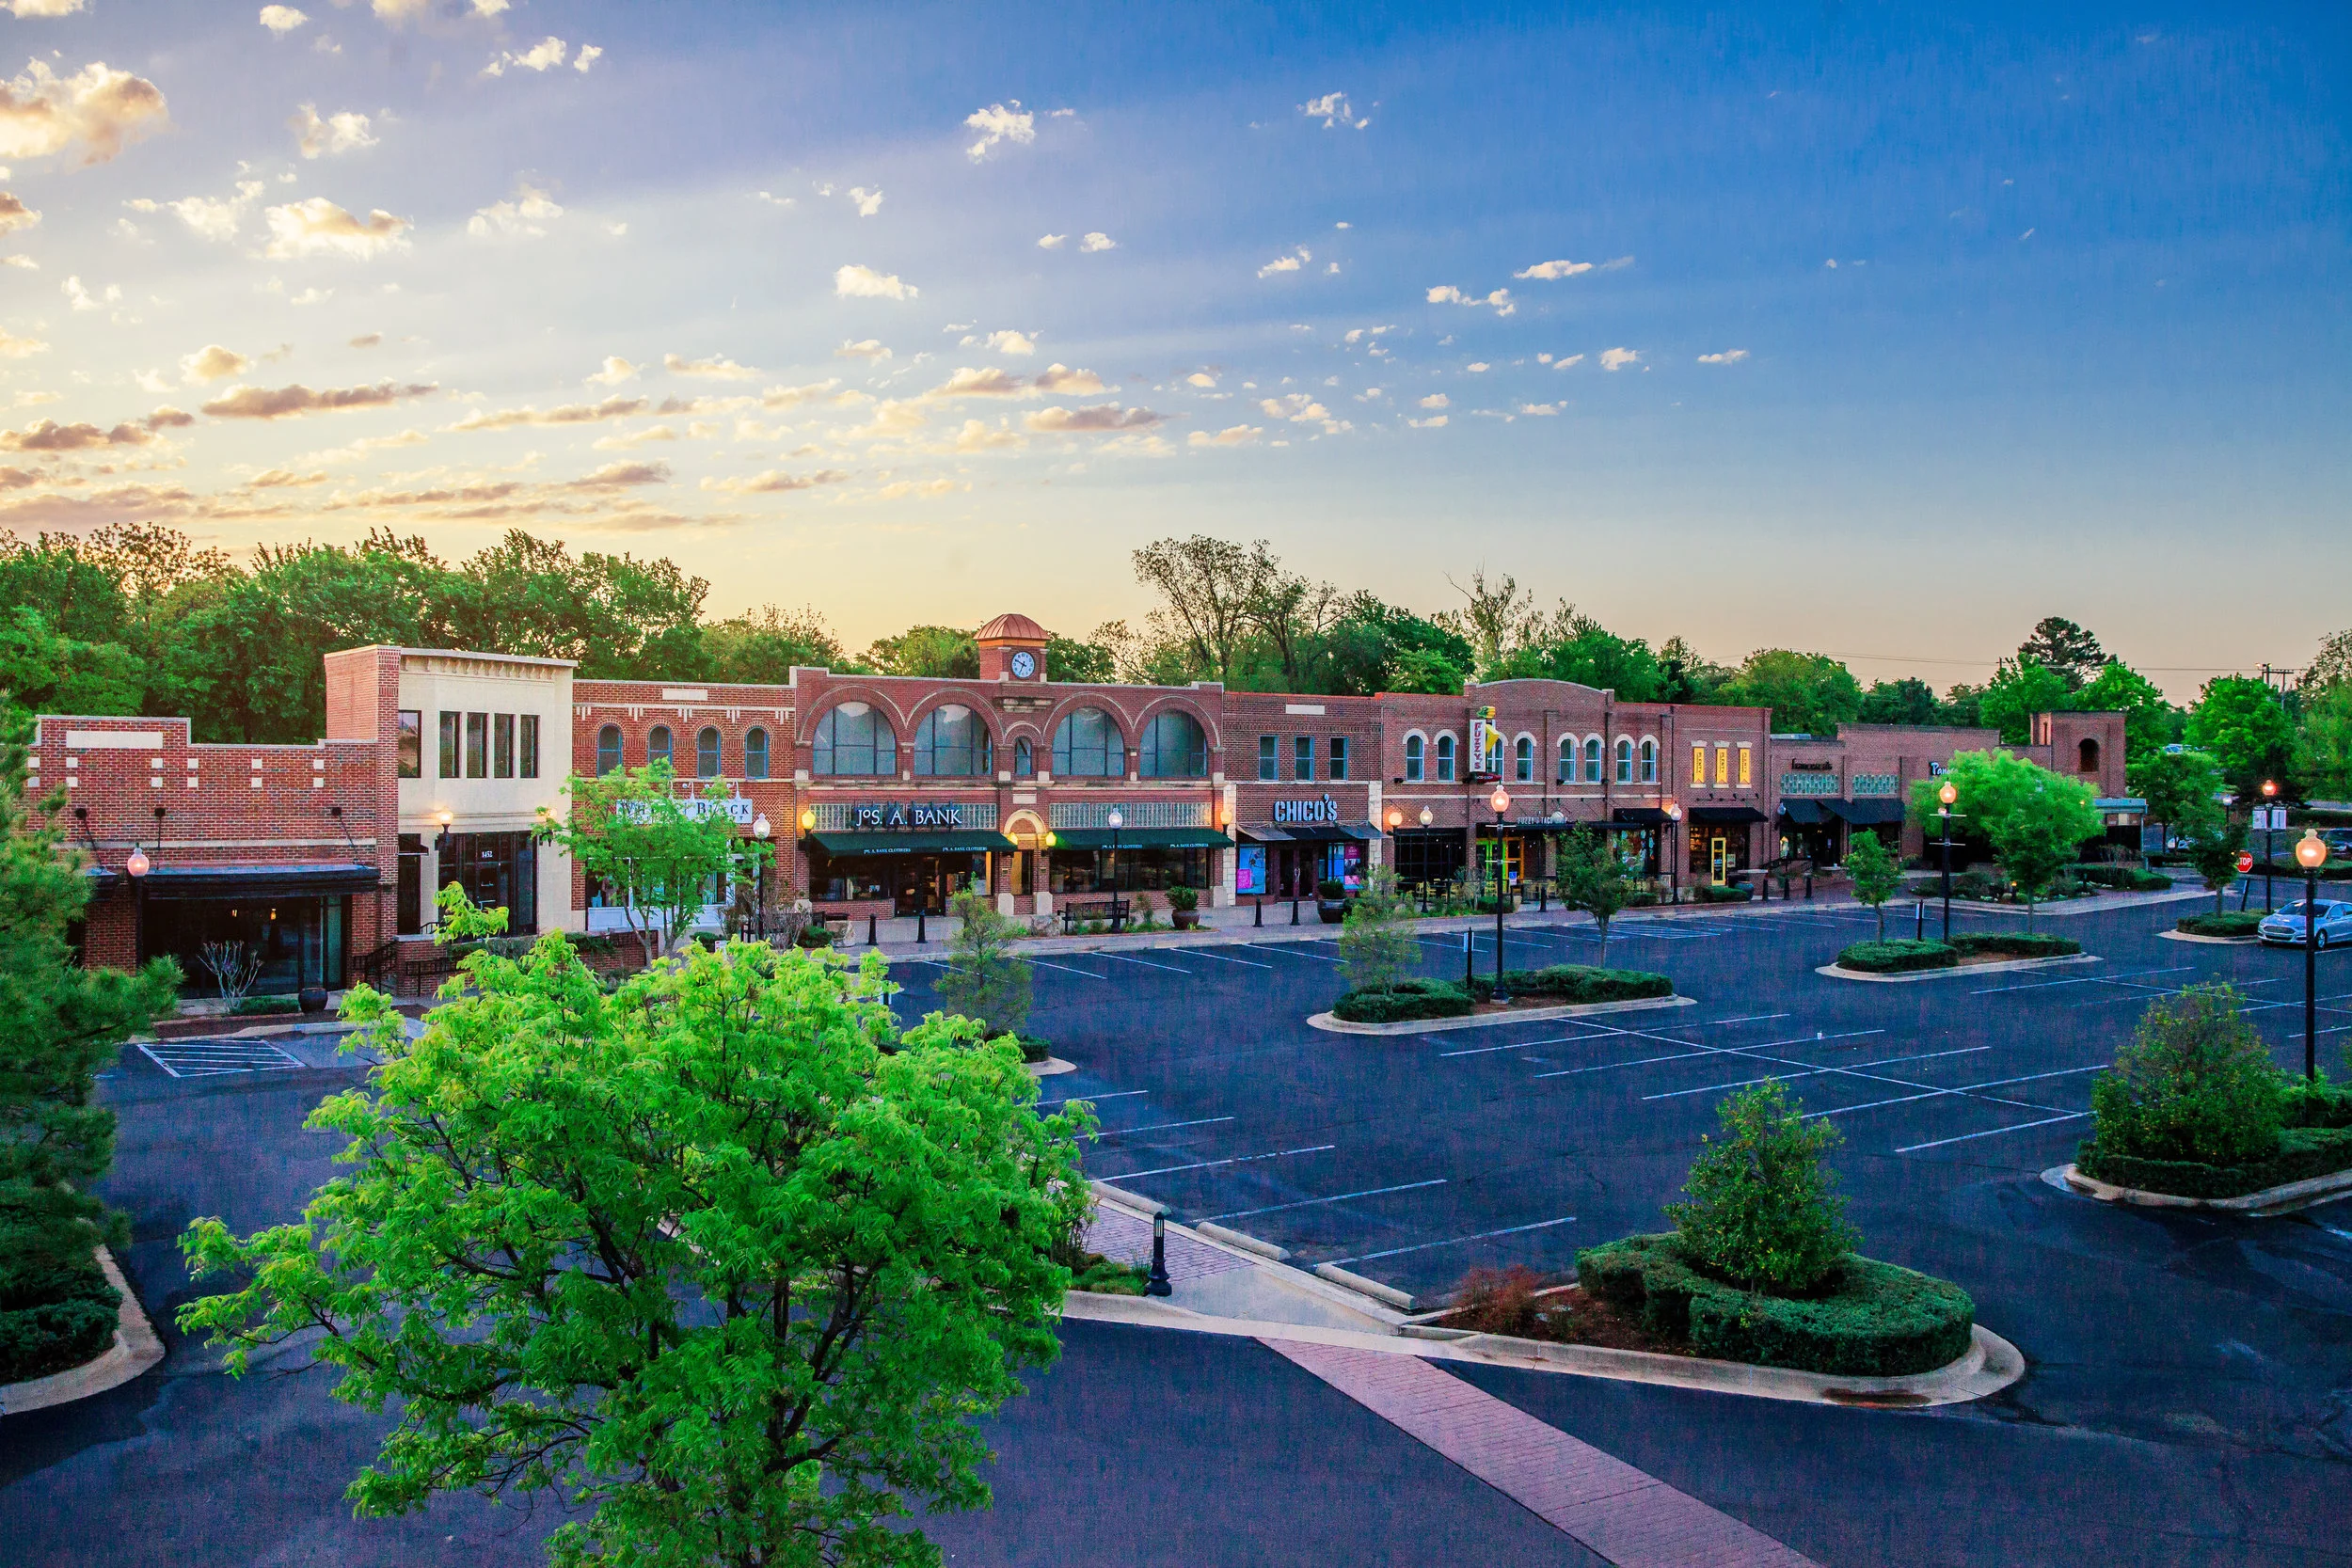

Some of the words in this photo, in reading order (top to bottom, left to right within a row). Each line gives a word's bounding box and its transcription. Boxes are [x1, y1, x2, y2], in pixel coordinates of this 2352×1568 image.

[890, 809, 908, 825] A.
[914, 809, 962, 825] BANK
[1274, 793, 1338, 822] CHICO'S
